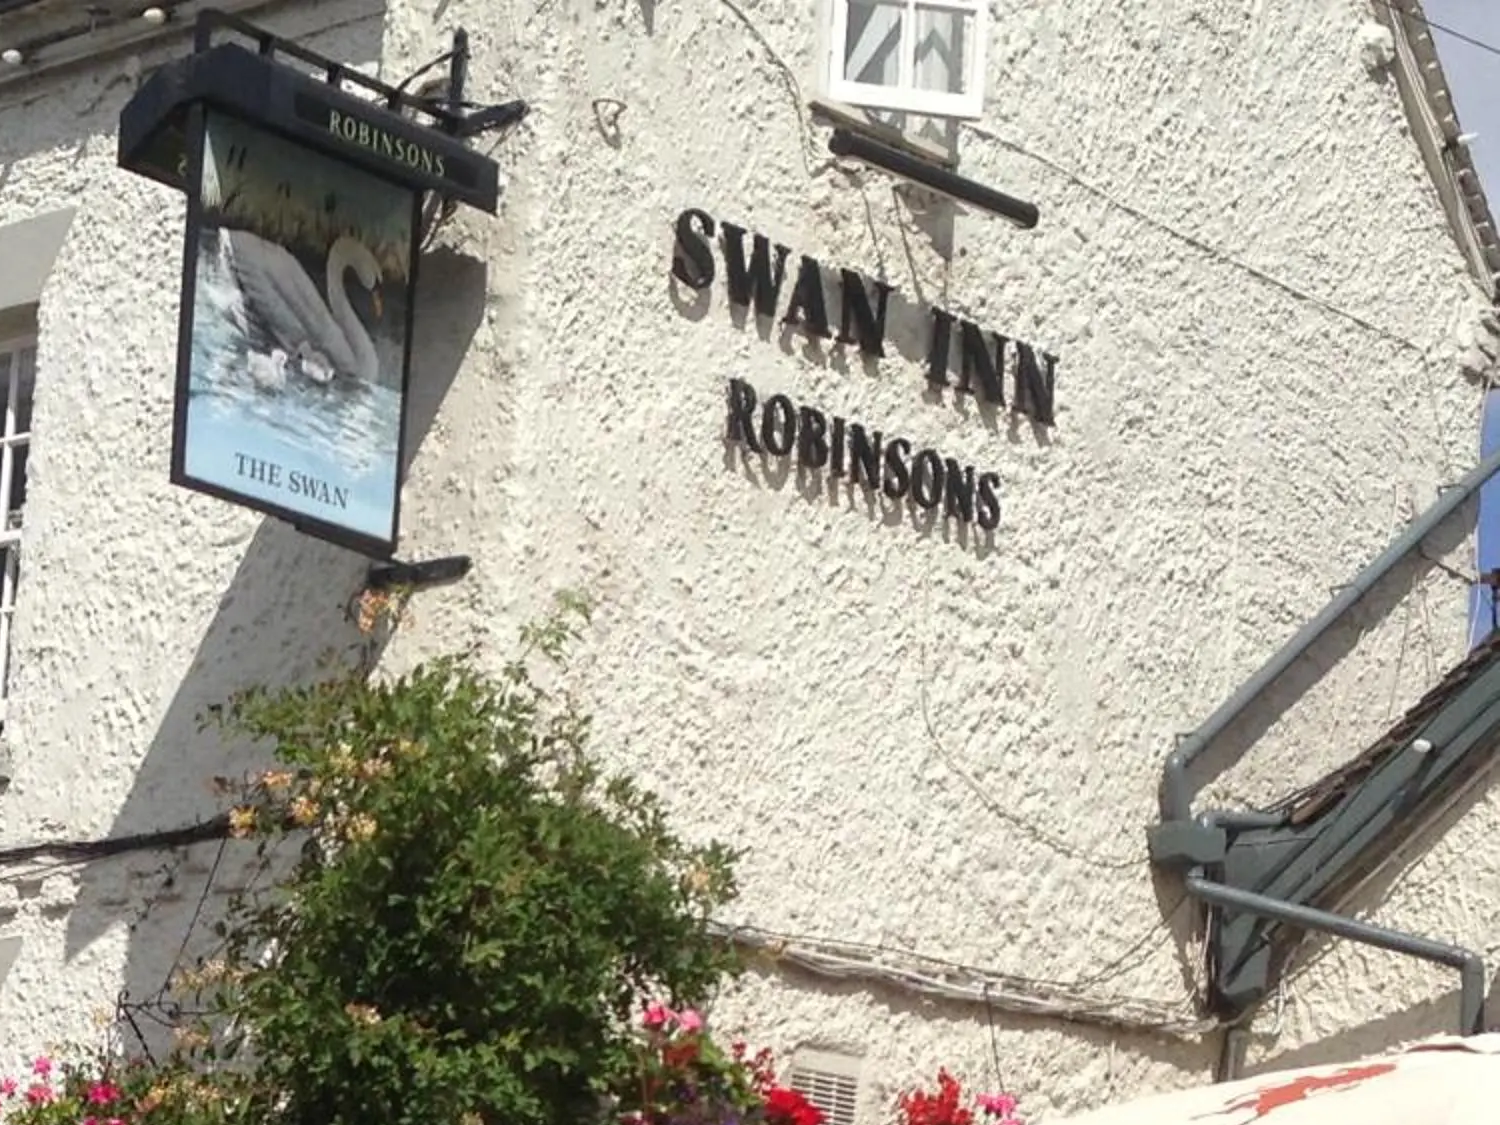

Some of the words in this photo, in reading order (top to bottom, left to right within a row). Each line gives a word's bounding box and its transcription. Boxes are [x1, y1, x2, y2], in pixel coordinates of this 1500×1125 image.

[328, 110, 445, 177] ROBINSONS
[670, 208, 895, 358] SWAN
[925, 306, 1060, 427] INN
[234, 451, 283, 489] THE
[287, 469, 349, 510] SWAN
[725, 377, 1001, 531] ROBINSONS
